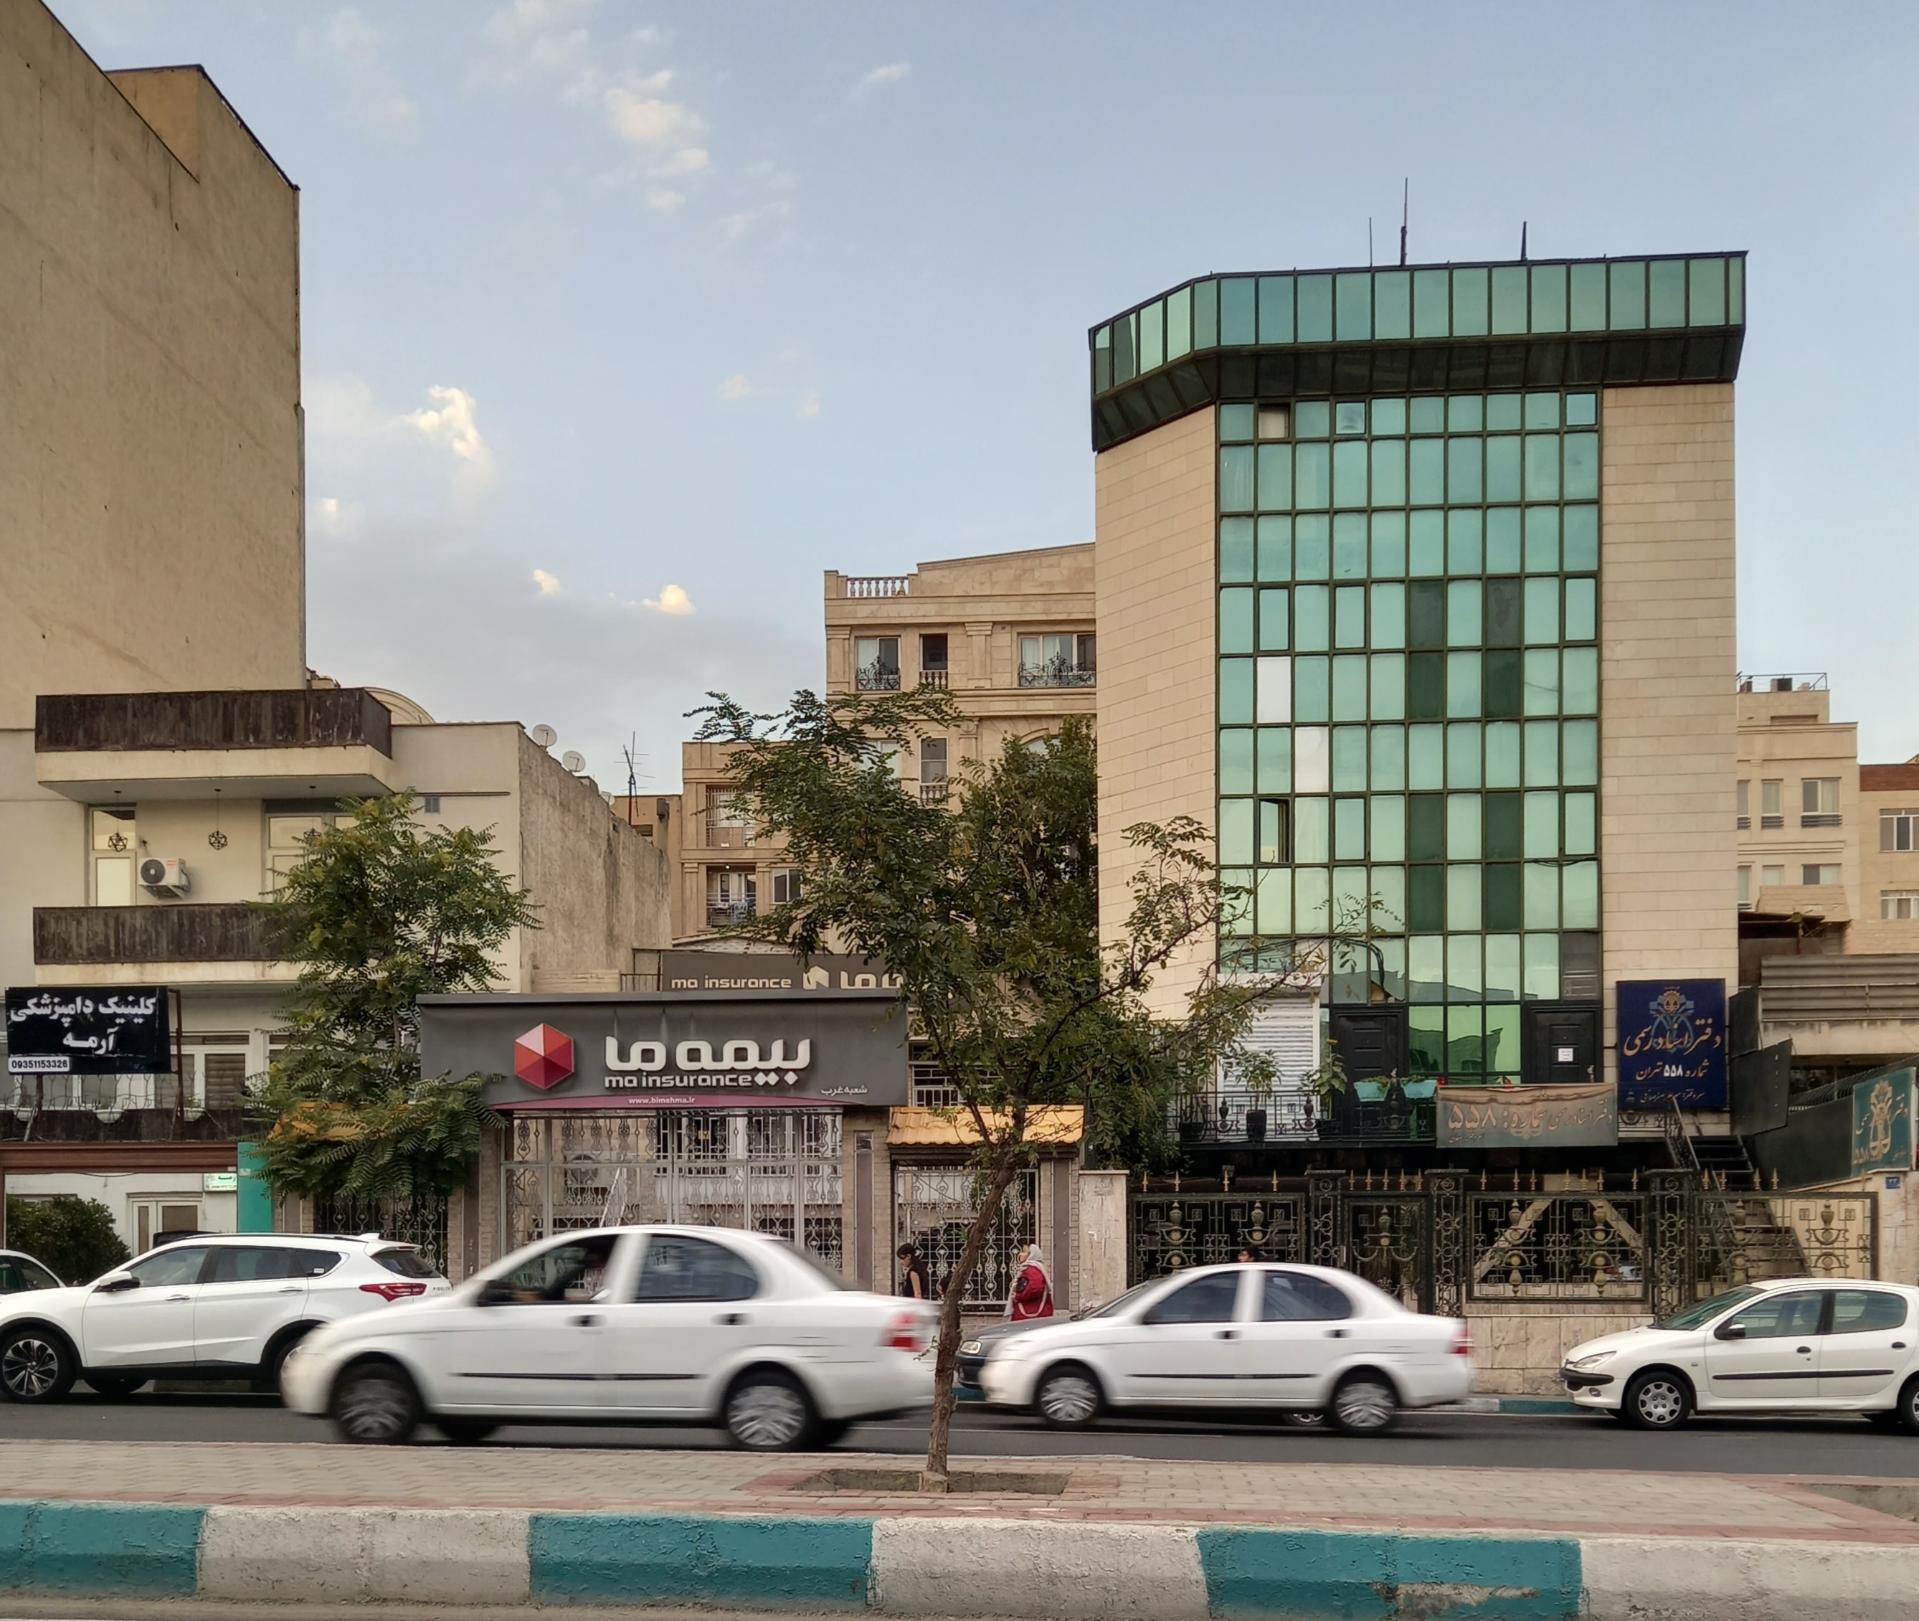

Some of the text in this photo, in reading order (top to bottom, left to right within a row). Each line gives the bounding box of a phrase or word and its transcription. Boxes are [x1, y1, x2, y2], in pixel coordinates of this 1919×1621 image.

[671, 975, 792, 989] ma insurance
[10, 993, 157, 1028] کلینیک دامپزشکی
[62, 1026, 120, 1055] آرمه
[1683, 1018, 1722, 1056] دفتر
[605, 1036, 811, 1087] بیمه ما
[1663, 1064, 1684, 1078] ۵۵۸
[604, 1072, 752, 1088] ma insurance
[843, 1084, 868, 1096] شعبه
[1448, 1104, 1497, 1130] ۵۵۸
